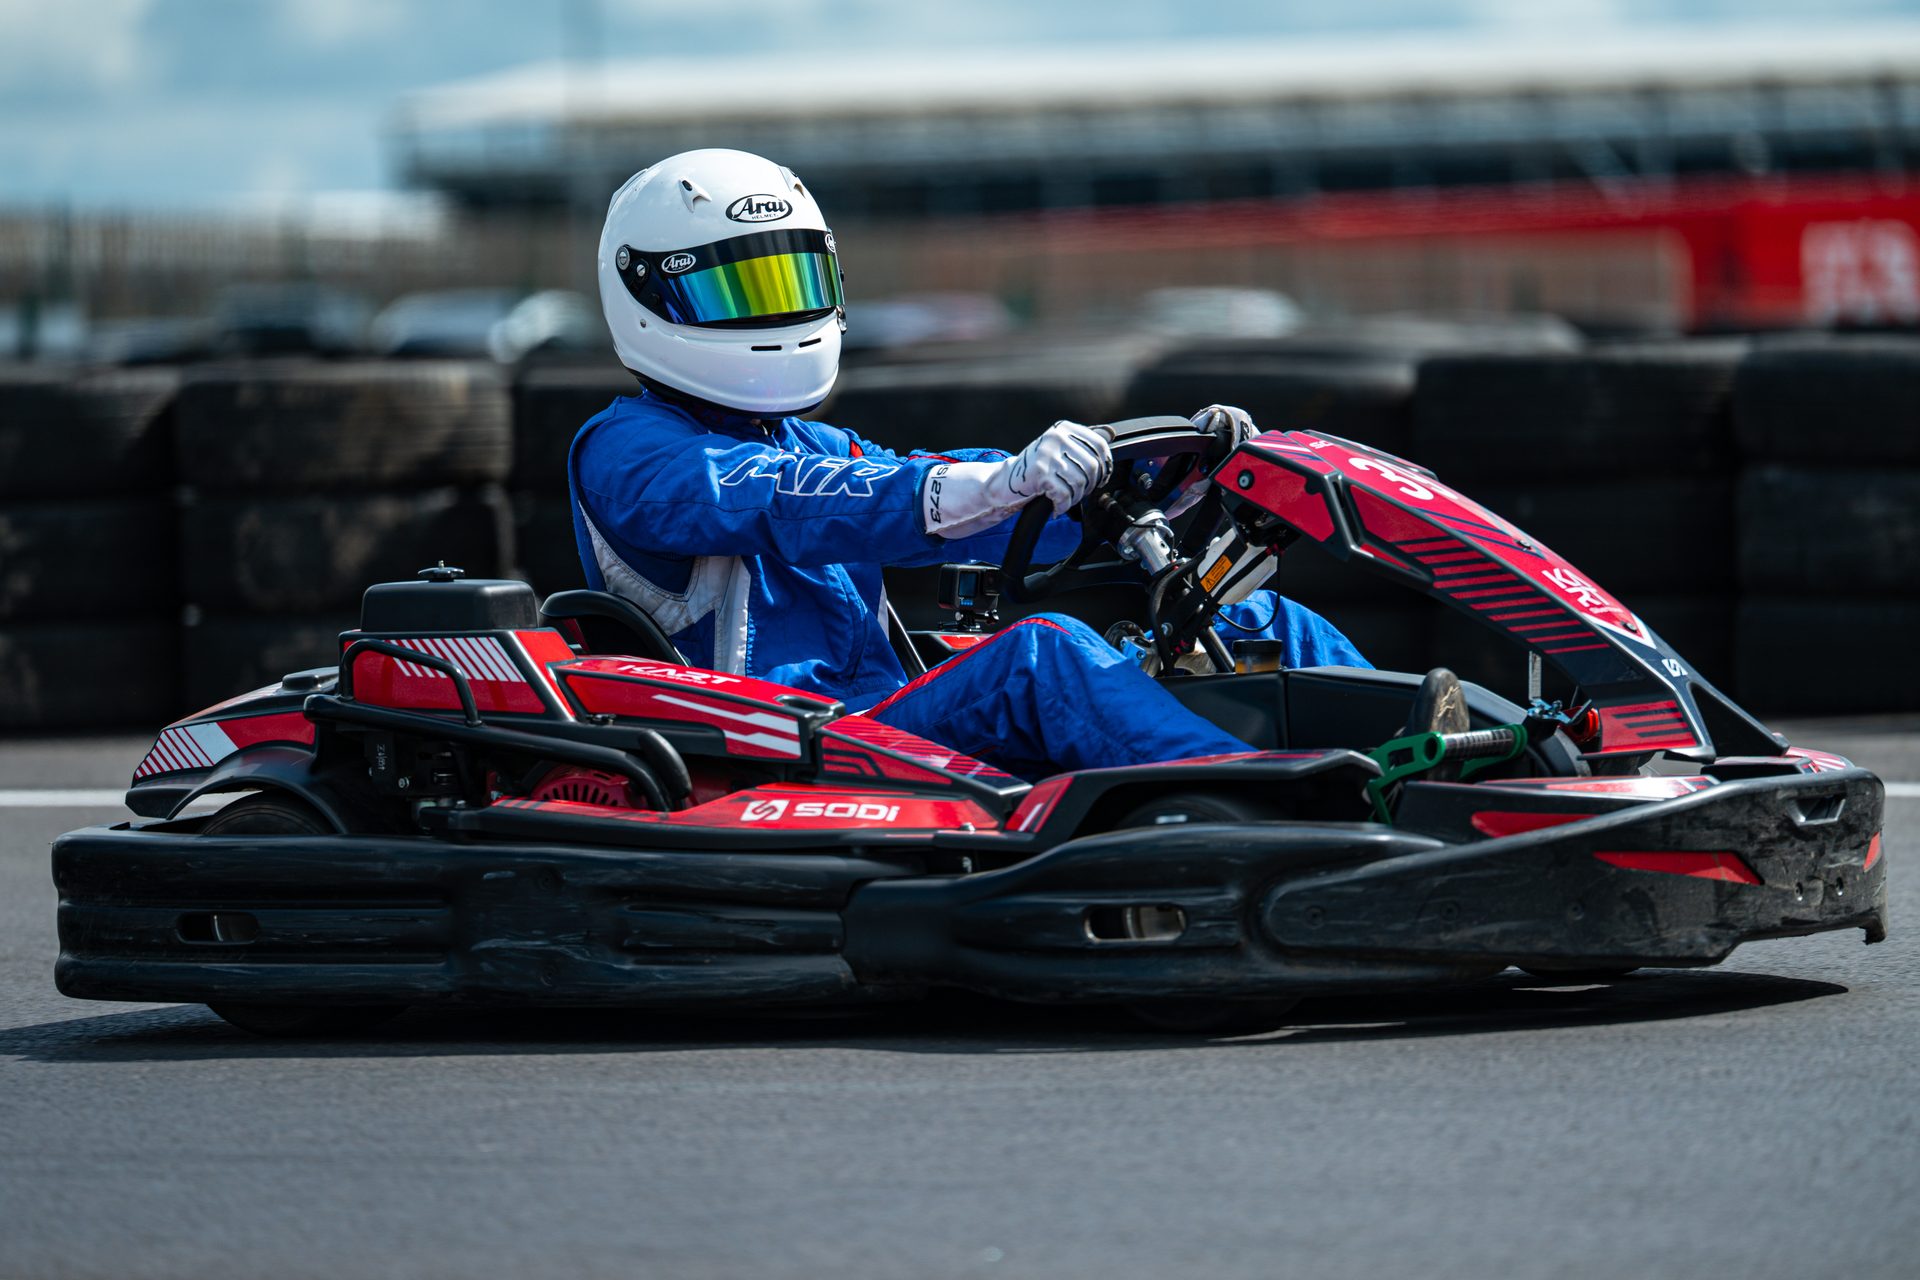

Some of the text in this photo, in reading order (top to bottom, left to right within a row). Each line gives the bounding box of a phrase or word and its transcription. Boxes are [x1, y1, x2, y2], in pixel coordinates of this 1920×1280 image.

[732, 197, 786, 219] Arai
[664, 255, 692, 270] Arai
[617, 664, 742, 685] KART
[793, 802, 901, 822] SODI
